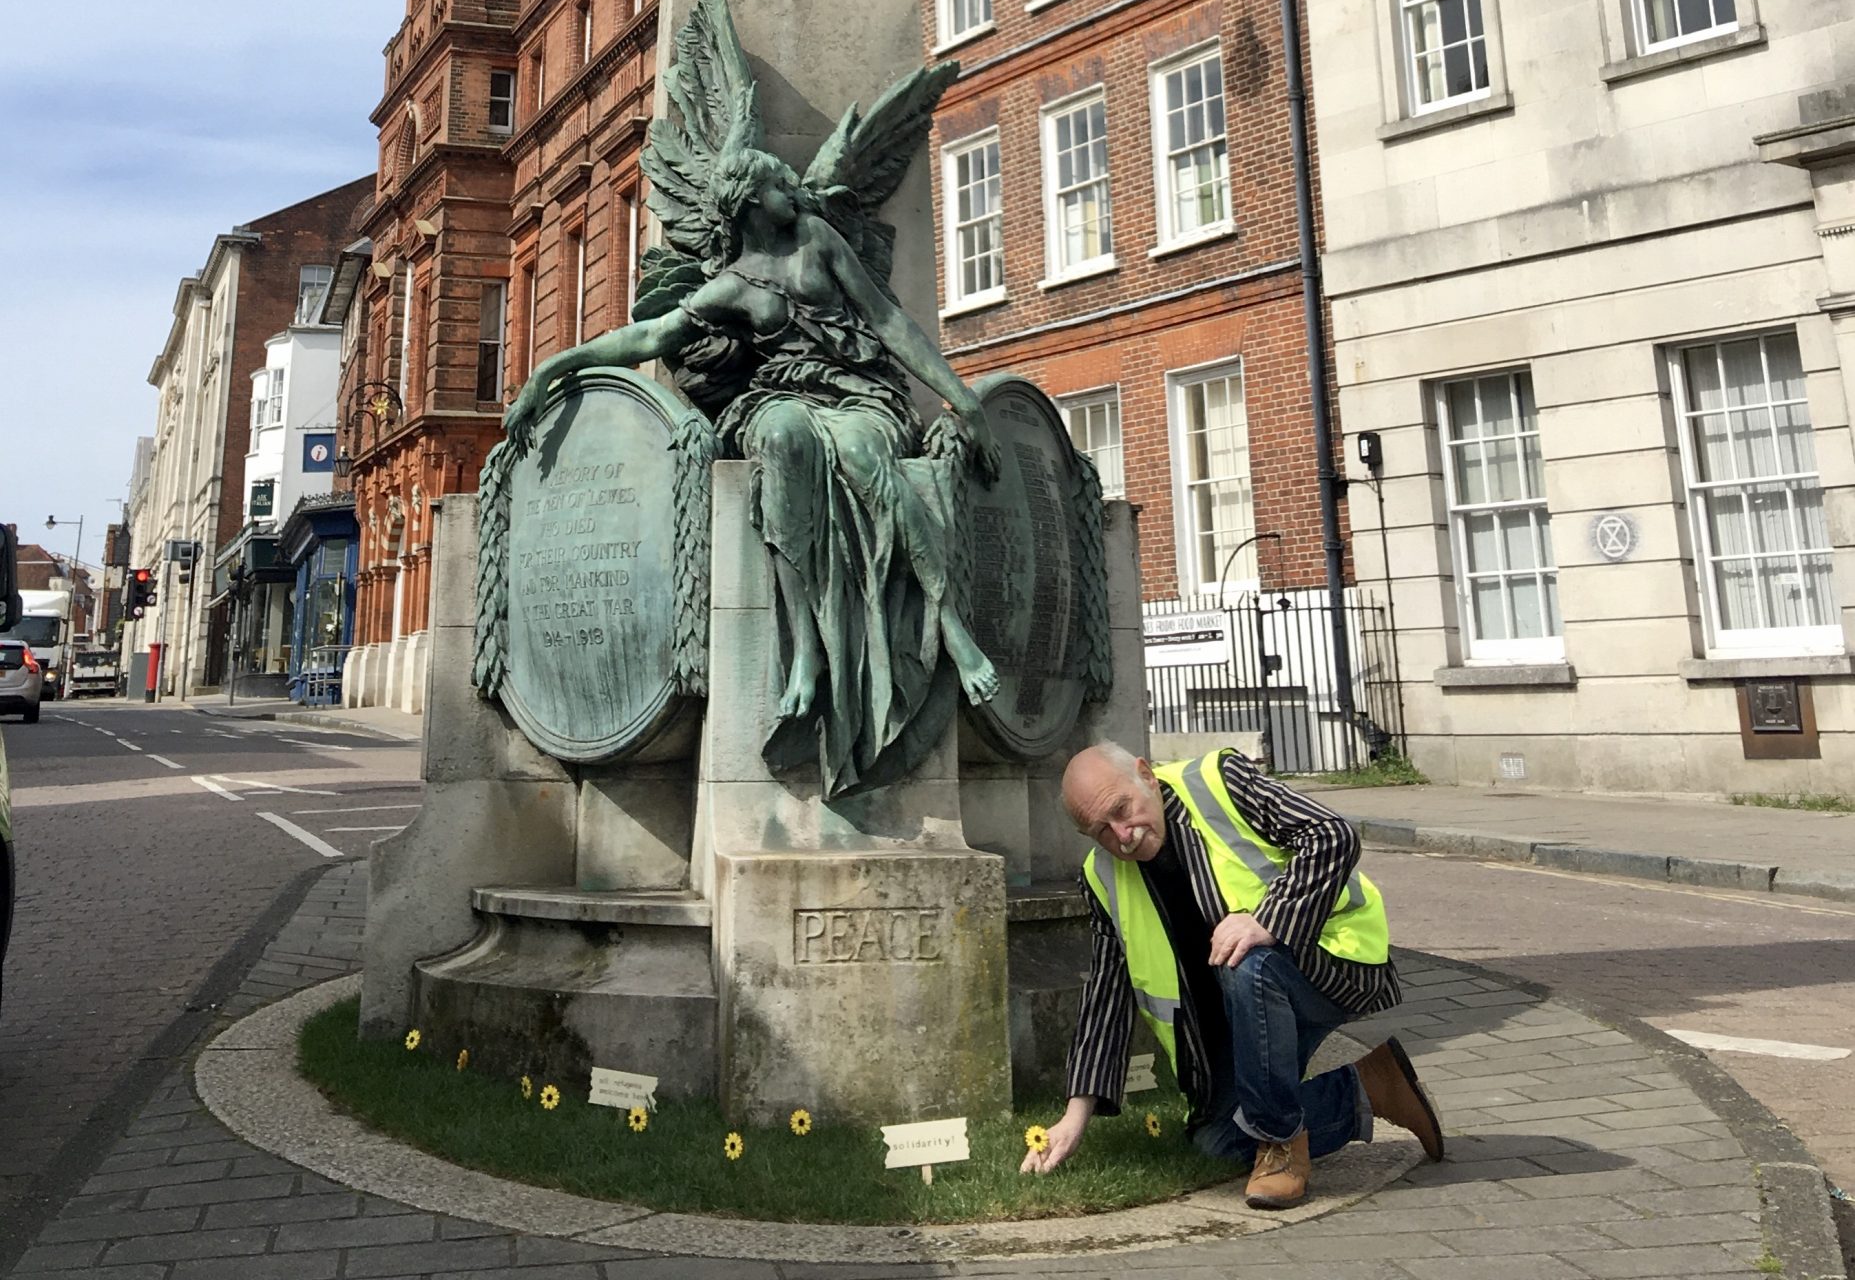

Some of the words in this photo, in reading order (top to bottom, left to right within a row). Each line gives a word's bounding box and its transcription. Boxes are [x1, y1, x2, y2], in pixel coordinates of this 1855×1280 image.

[604, 463, 625, 481] OF
[543, 495, 565, 513] MEN
[567, 491, 586, 509] OF
[565, 518, 597, 536] DIED
[535, 547, 567, 566] THEIR
[572, 541, 642, 562] COUNTRY
[540, 576, 561, 593] FOR
[565, 570, 631, 589] MANKIND
[533, 604, 551, 621] THE
[554, 600, 595, 619] GREAT
[602, 598, 636, 616] WAR
[1196, 615, 1222, 628] MARKET
[798, 910, 942, 962] PEACE
[893, 1136, 955, 1150] solidarity!
